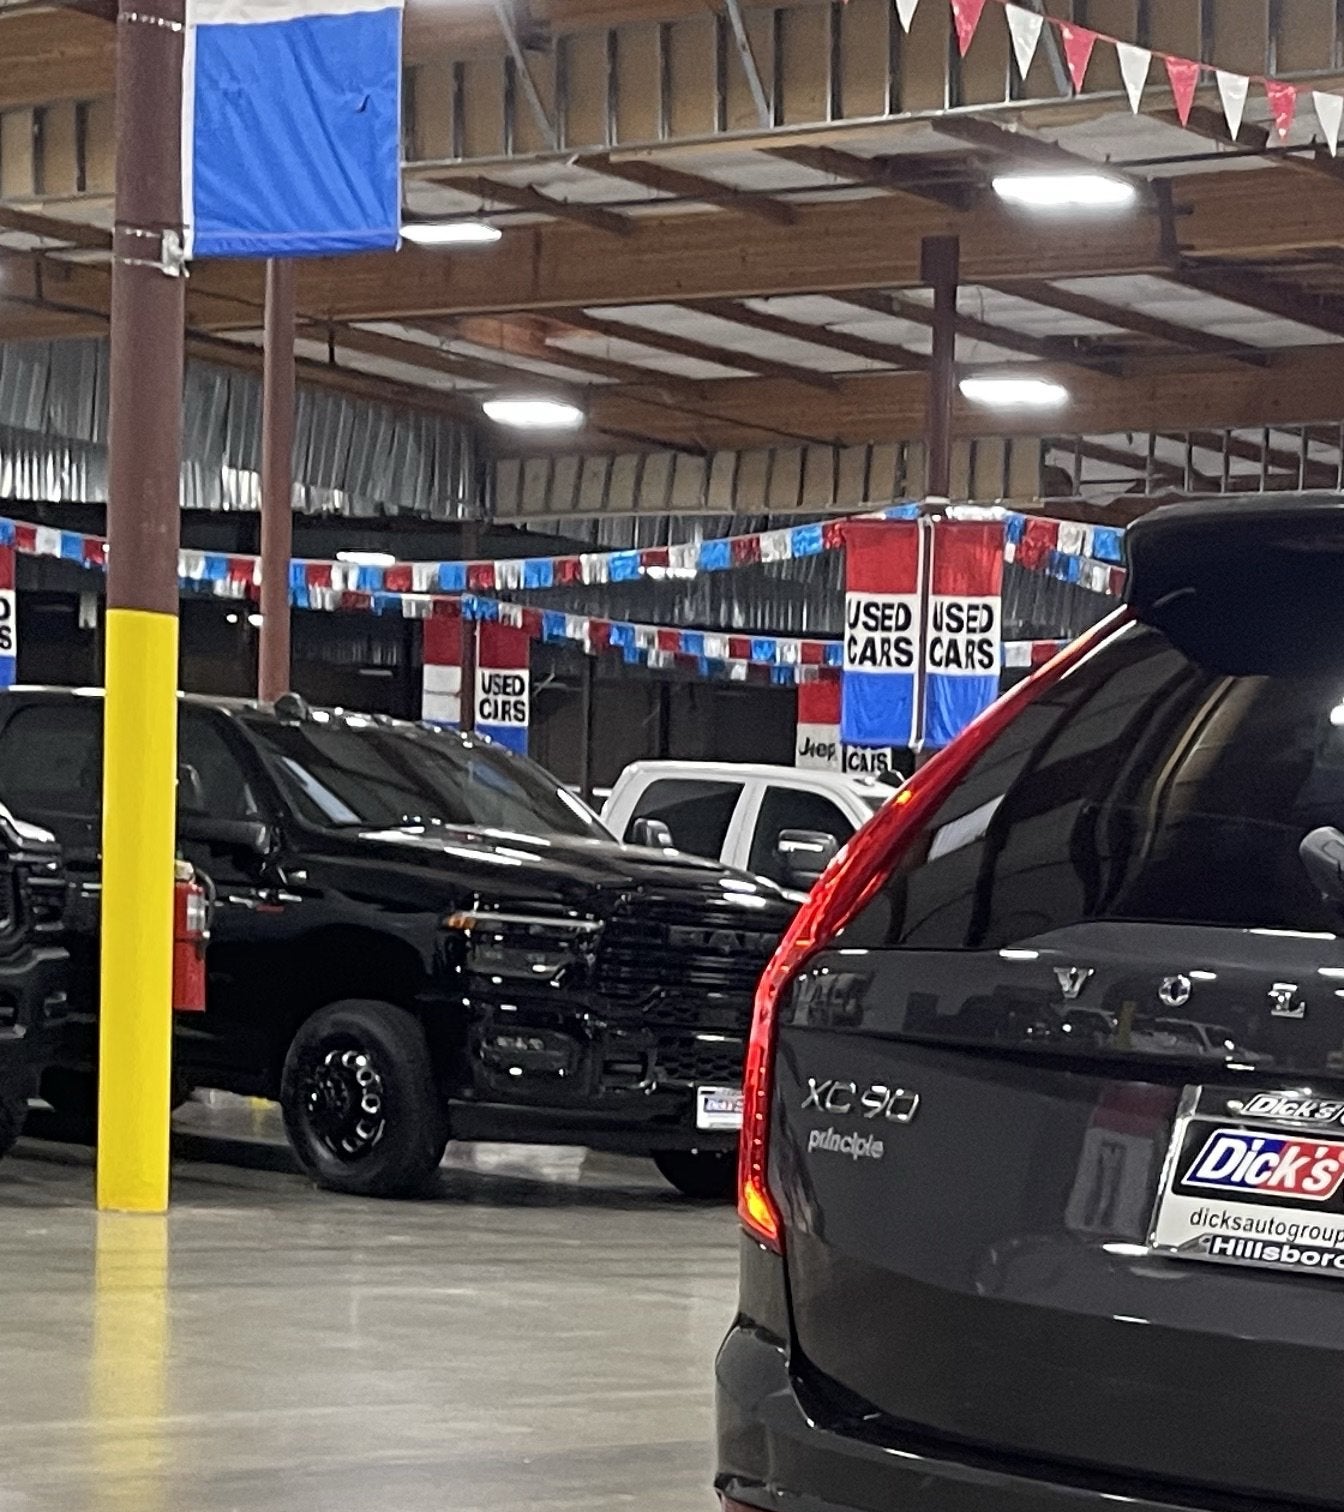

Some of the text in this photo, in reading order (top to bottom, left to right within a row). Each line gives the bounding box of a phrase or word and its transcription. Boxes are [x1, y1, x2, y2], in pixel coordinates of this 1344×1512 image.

[848, 601, 912, 632] USED
[932, 601, 994, 633] USED
[847, 634, 914, 667] CARS
[929, 636, 994, 669] CARS
[481, 671, 525, 696] USED
